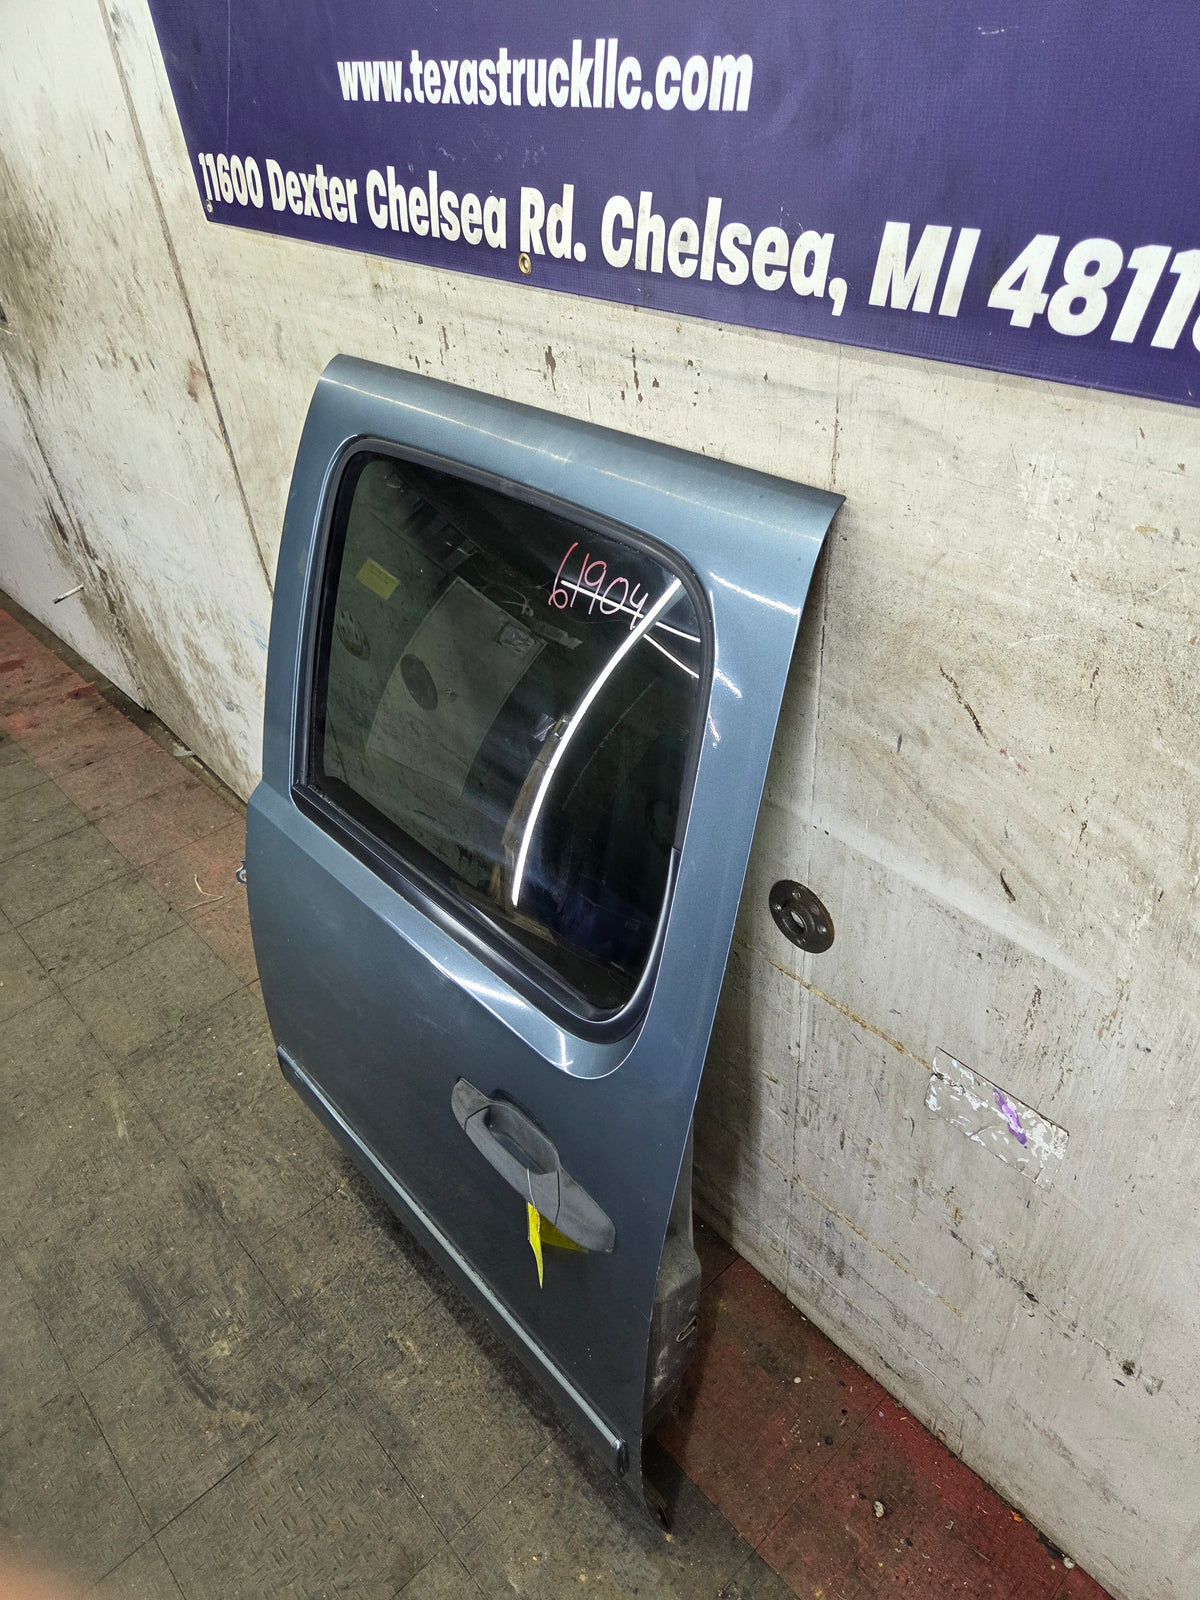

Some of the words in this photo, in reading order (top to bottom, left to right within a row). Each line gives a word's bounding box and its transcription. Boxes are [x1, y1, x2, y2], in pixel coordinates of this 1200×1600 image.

[337, 38, 754, 112] www.texastruckllc.com
[198, 152, 262, 209] 11600
[265, 158, 359, 224] Dexter
[365, 164, 507, 250] Chelsea
[519, 183, 587, 263] Rd.
[601, 190, 848, 317] Chelsea,
[868, 220, 982, 317] MI
[987, 234, 1200, 355] 4811
[548, 541, 649, 630] 61904
